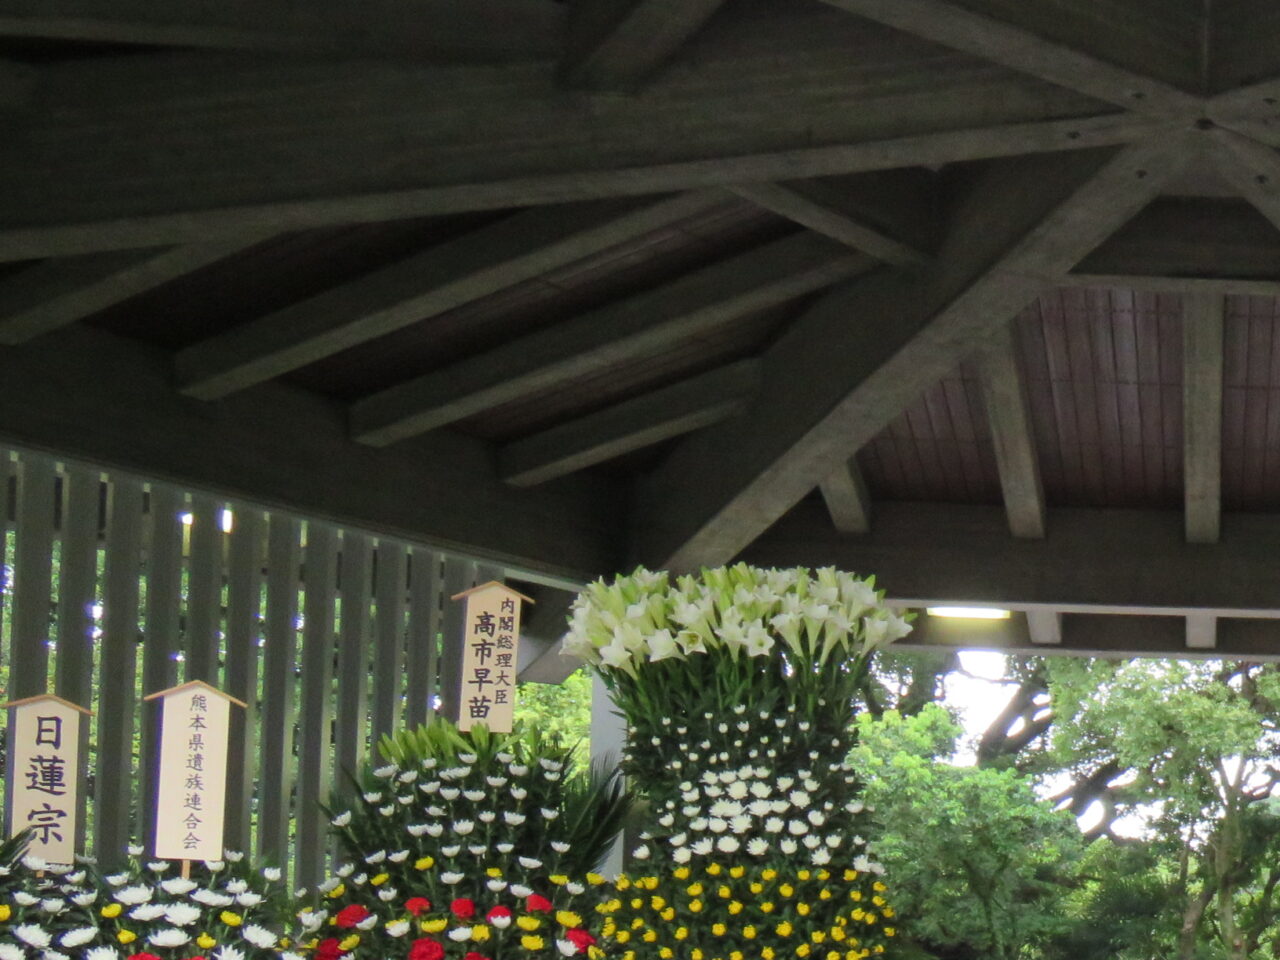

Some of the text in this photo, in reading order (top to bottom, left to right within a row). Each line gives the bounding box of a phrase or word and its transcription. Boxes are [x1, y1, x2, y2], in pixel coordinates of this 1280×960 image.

[468, 611, 496, 719] 高市早苗
[494, 597, 515, 705] 内閣総理大臣
[25, 715, 67, 845] 日蓮宗
[183, 694, 207, 850] 熊本県遺族連合会
